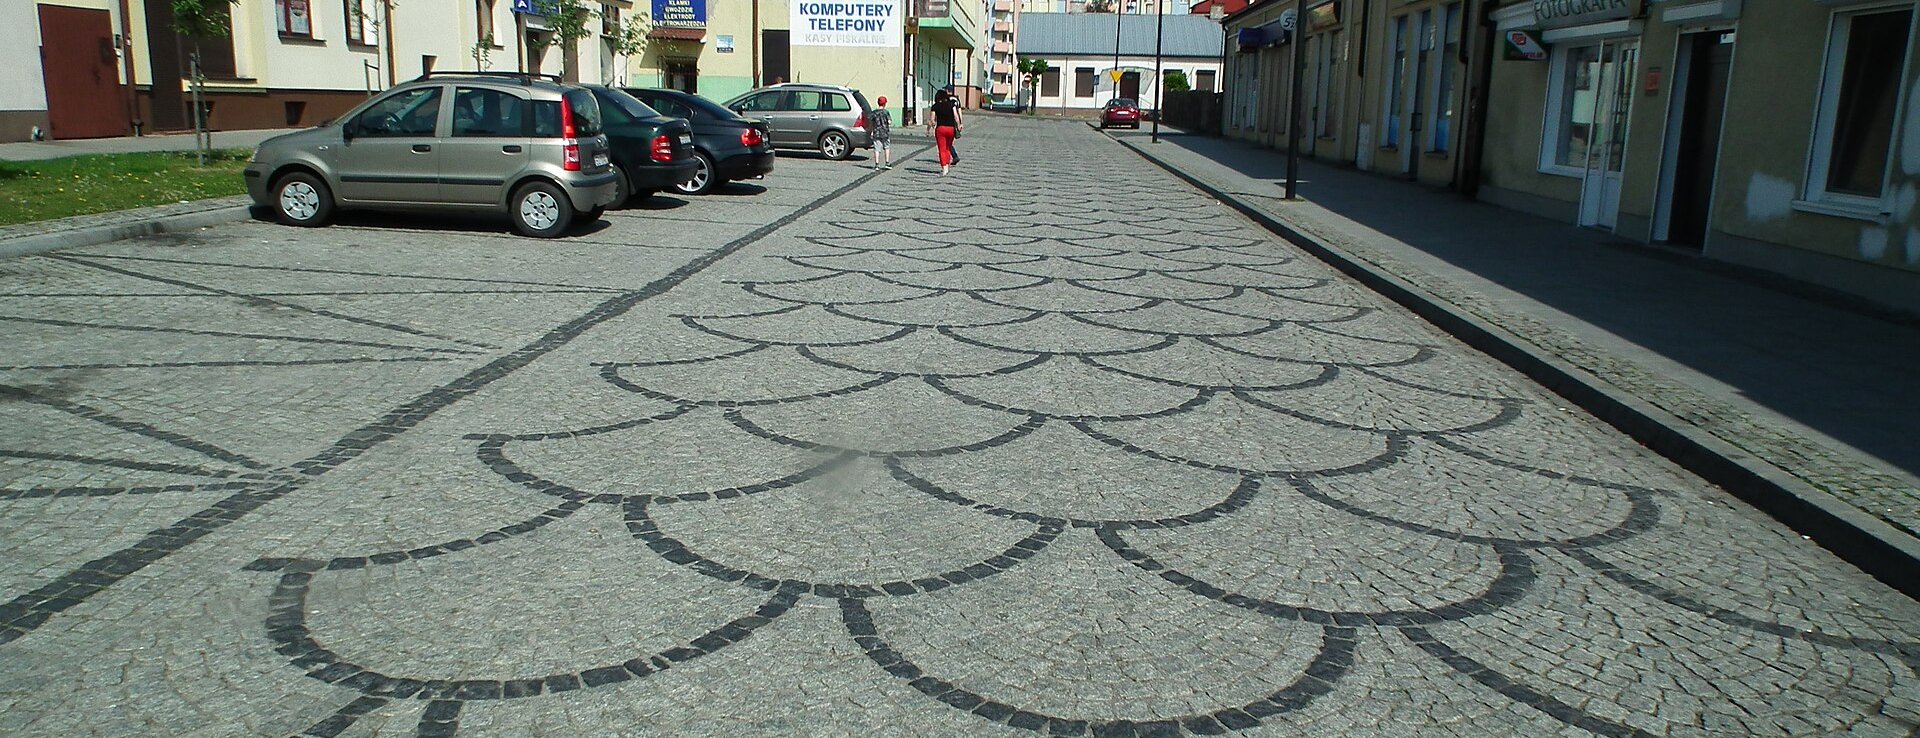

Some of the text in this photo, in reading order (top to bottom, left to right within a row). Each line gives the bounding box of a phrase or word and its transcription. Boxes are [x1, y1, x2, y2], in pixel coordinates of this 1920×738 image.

[799, 3, 893, 17] KOMPUTERY
[809, 18, 885, 31] TELEFONY
[805, 33, 886, 44] KASY FISKALNE
